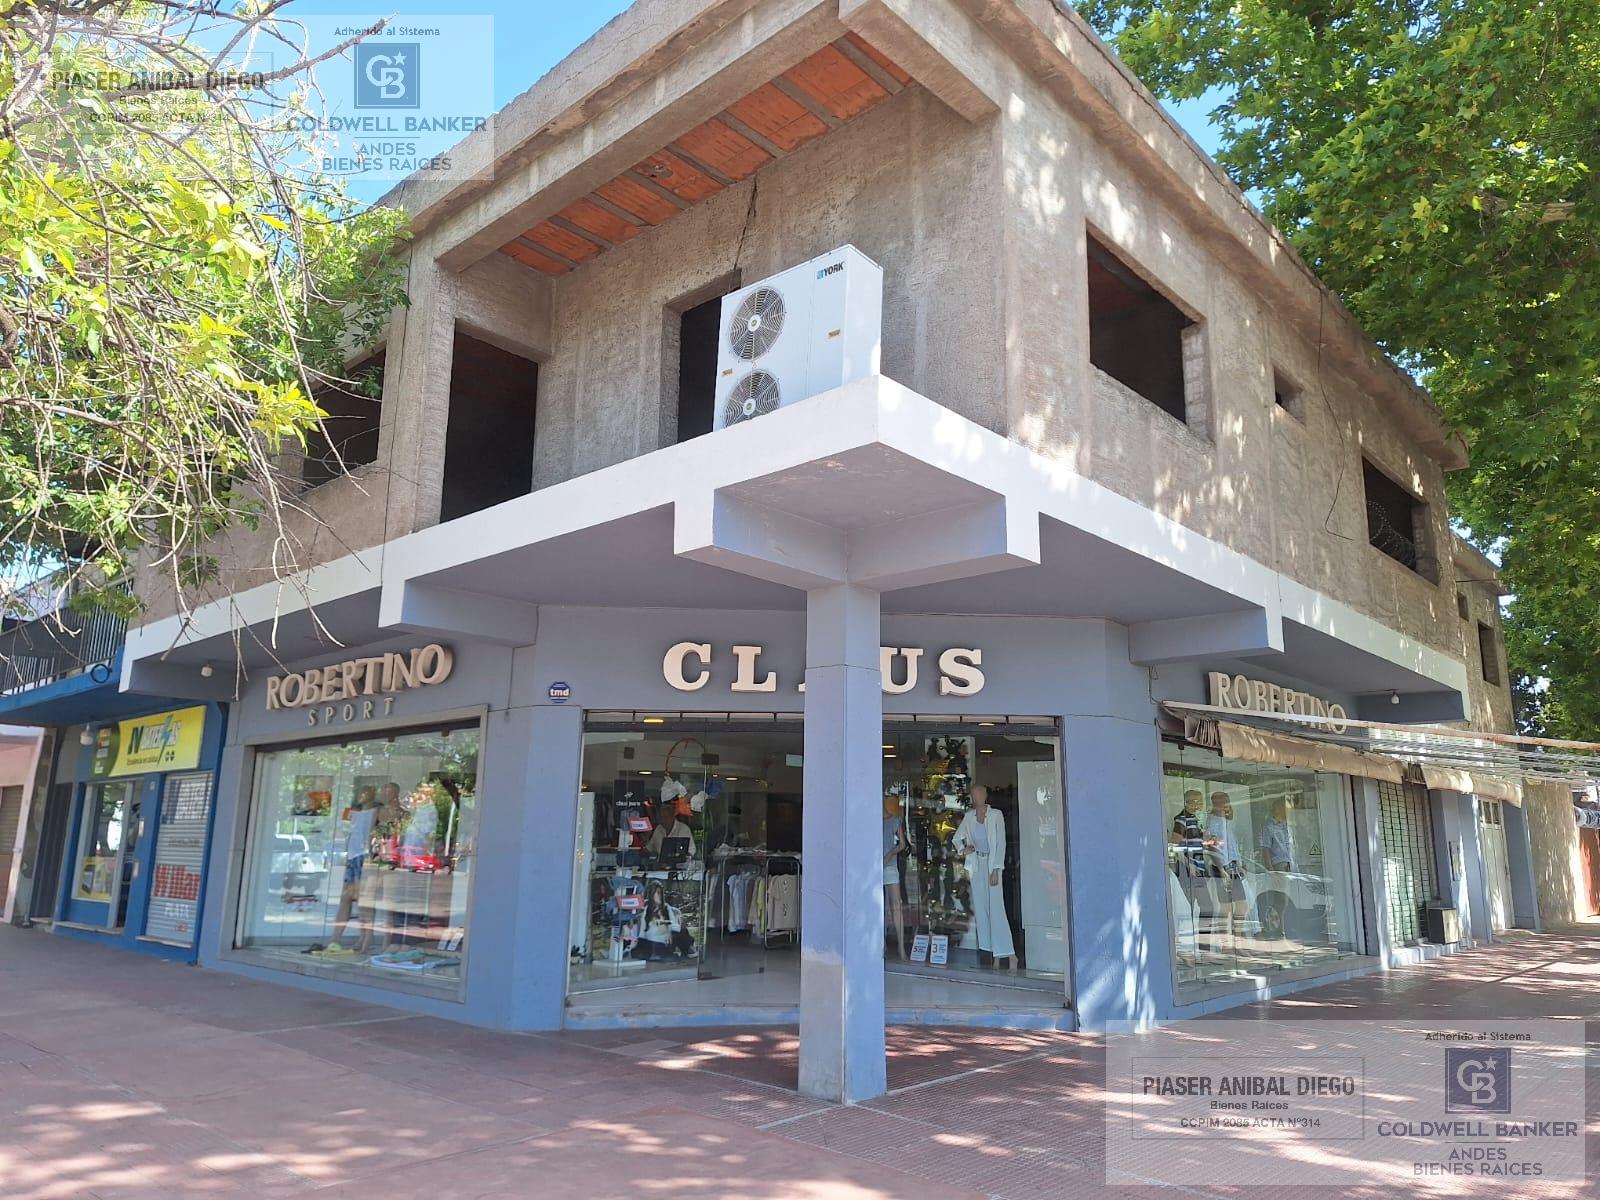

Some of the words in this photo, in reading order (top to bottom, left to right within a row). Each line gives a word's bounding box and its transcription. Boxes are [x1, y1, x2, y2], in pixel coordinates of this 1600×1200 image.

[823, 261, 844, 277] YORK
[266, 643, 452, 710] ROBERTINO
[663, 641, 986, 697] CLUS
[308, 697, 396, 727] SPORT
[1208, 671, 1347, 735] ROBERTINO
